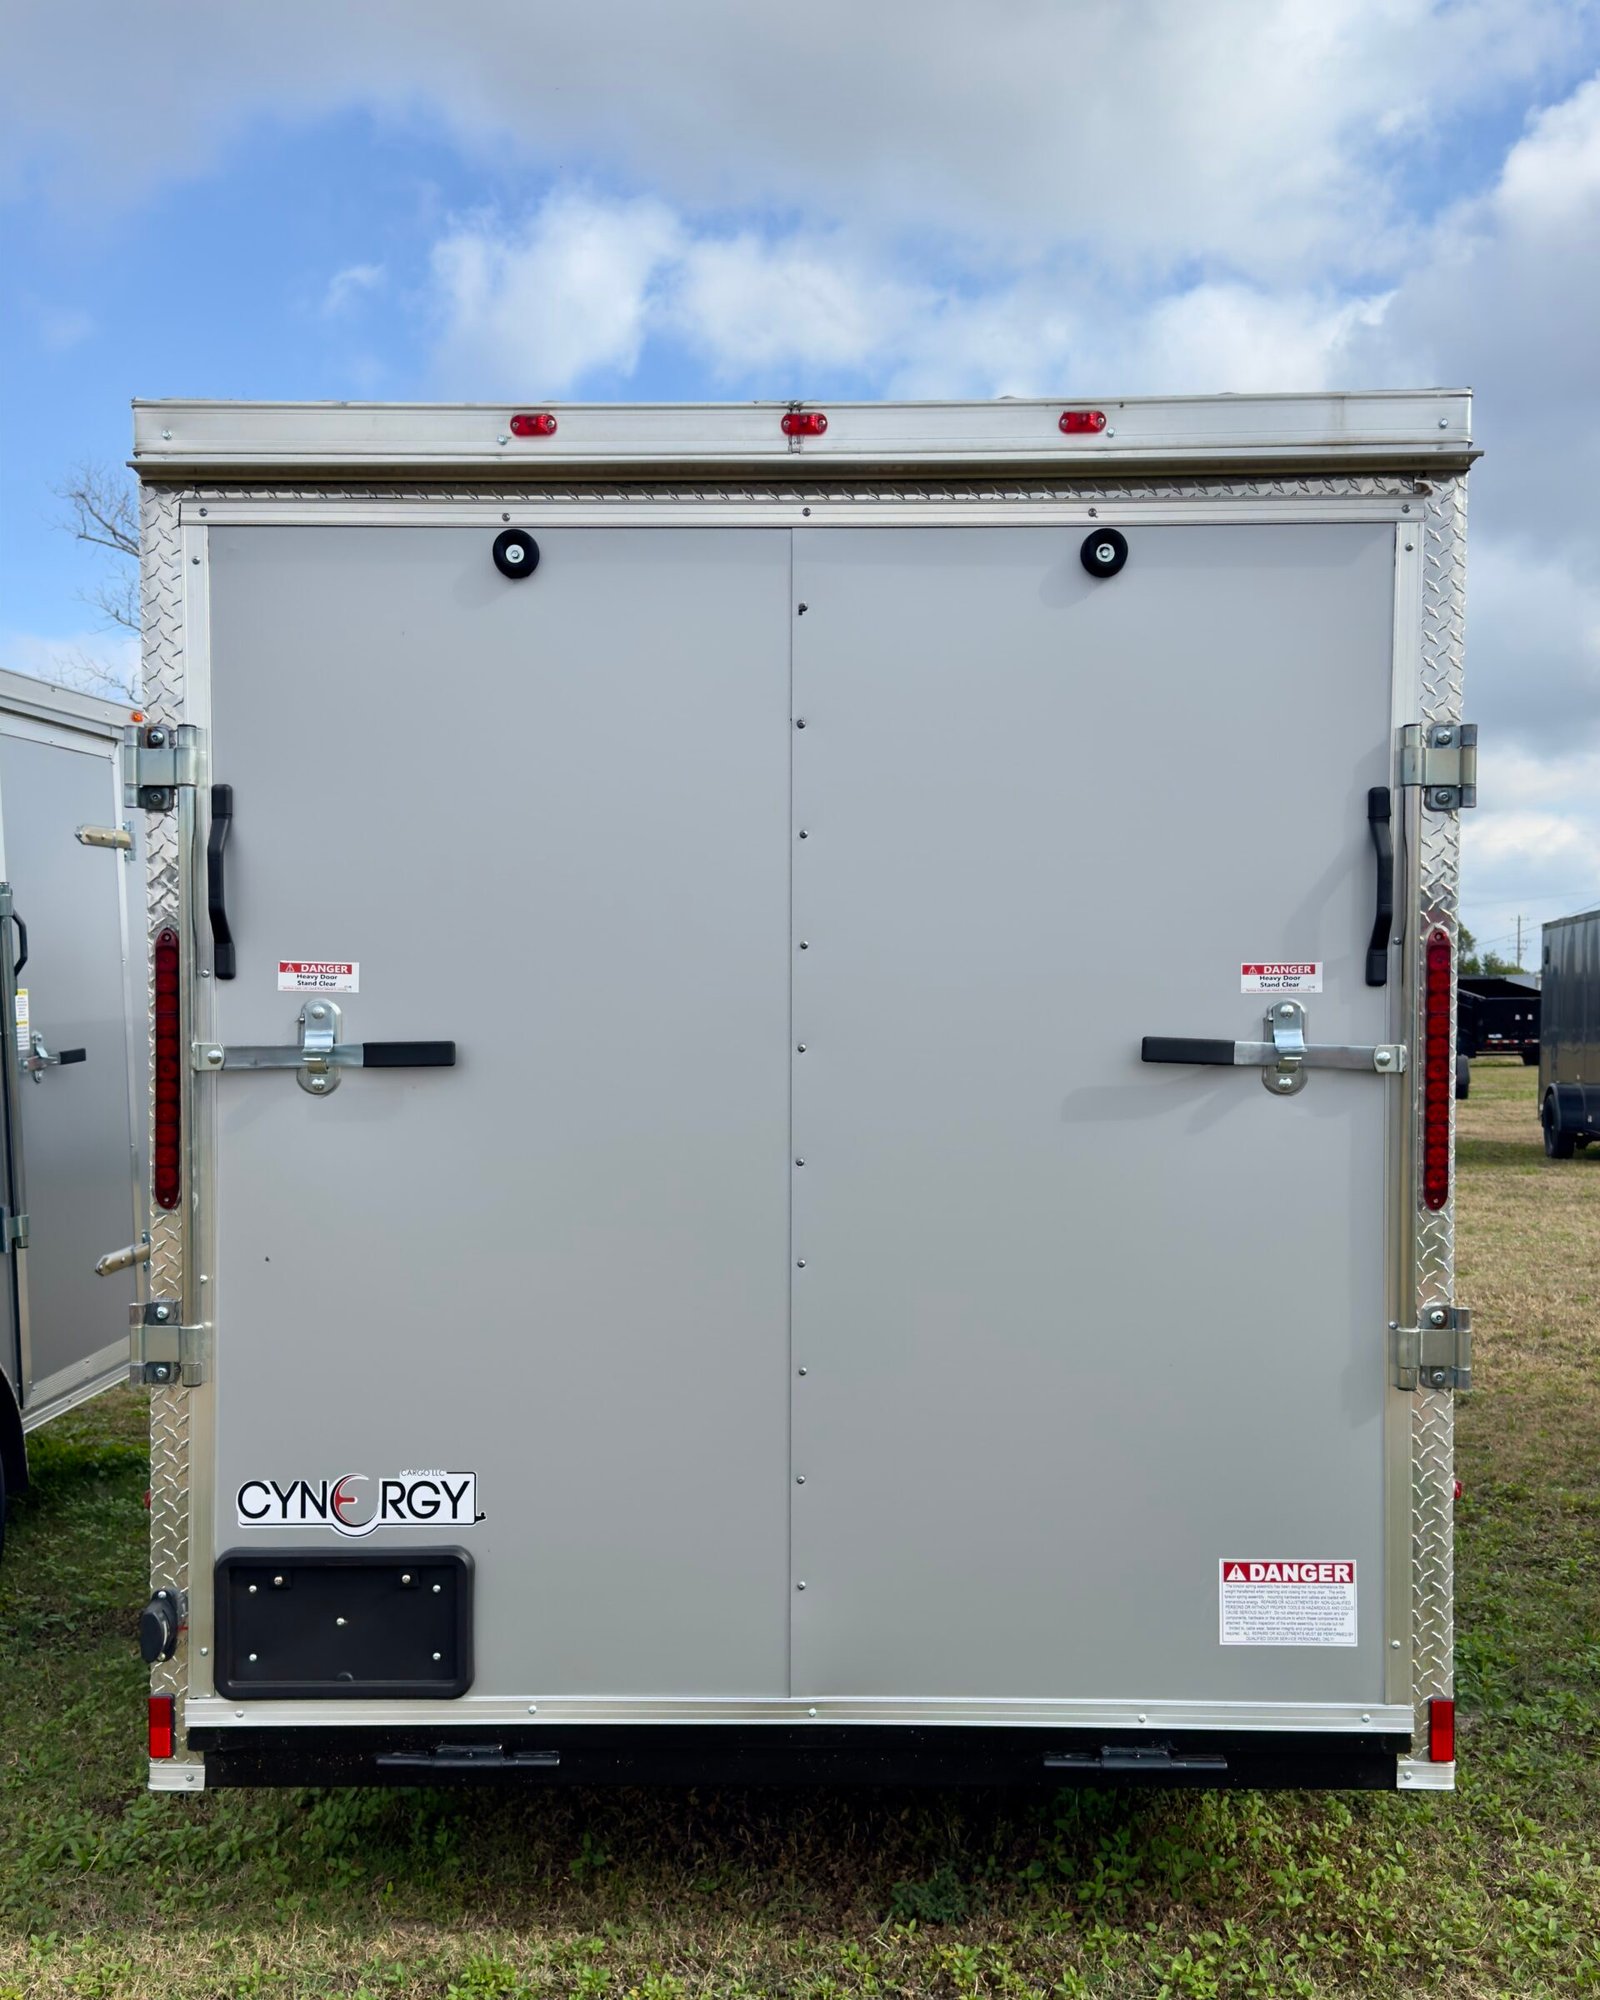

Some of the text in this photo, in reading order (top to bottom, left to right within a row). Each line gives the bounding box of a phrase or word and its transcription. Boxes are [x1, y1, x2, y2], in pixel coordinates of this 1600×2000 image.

[301, 964, 348, 974] DANGER
[1263, 965, 1311, 974] DANGER
[401, 1469, 445, 1477] CARGO LLC
[237, 1473, 470, 1527] CYNERGY
[1249, 1563, 1351, 1582] DANGER
